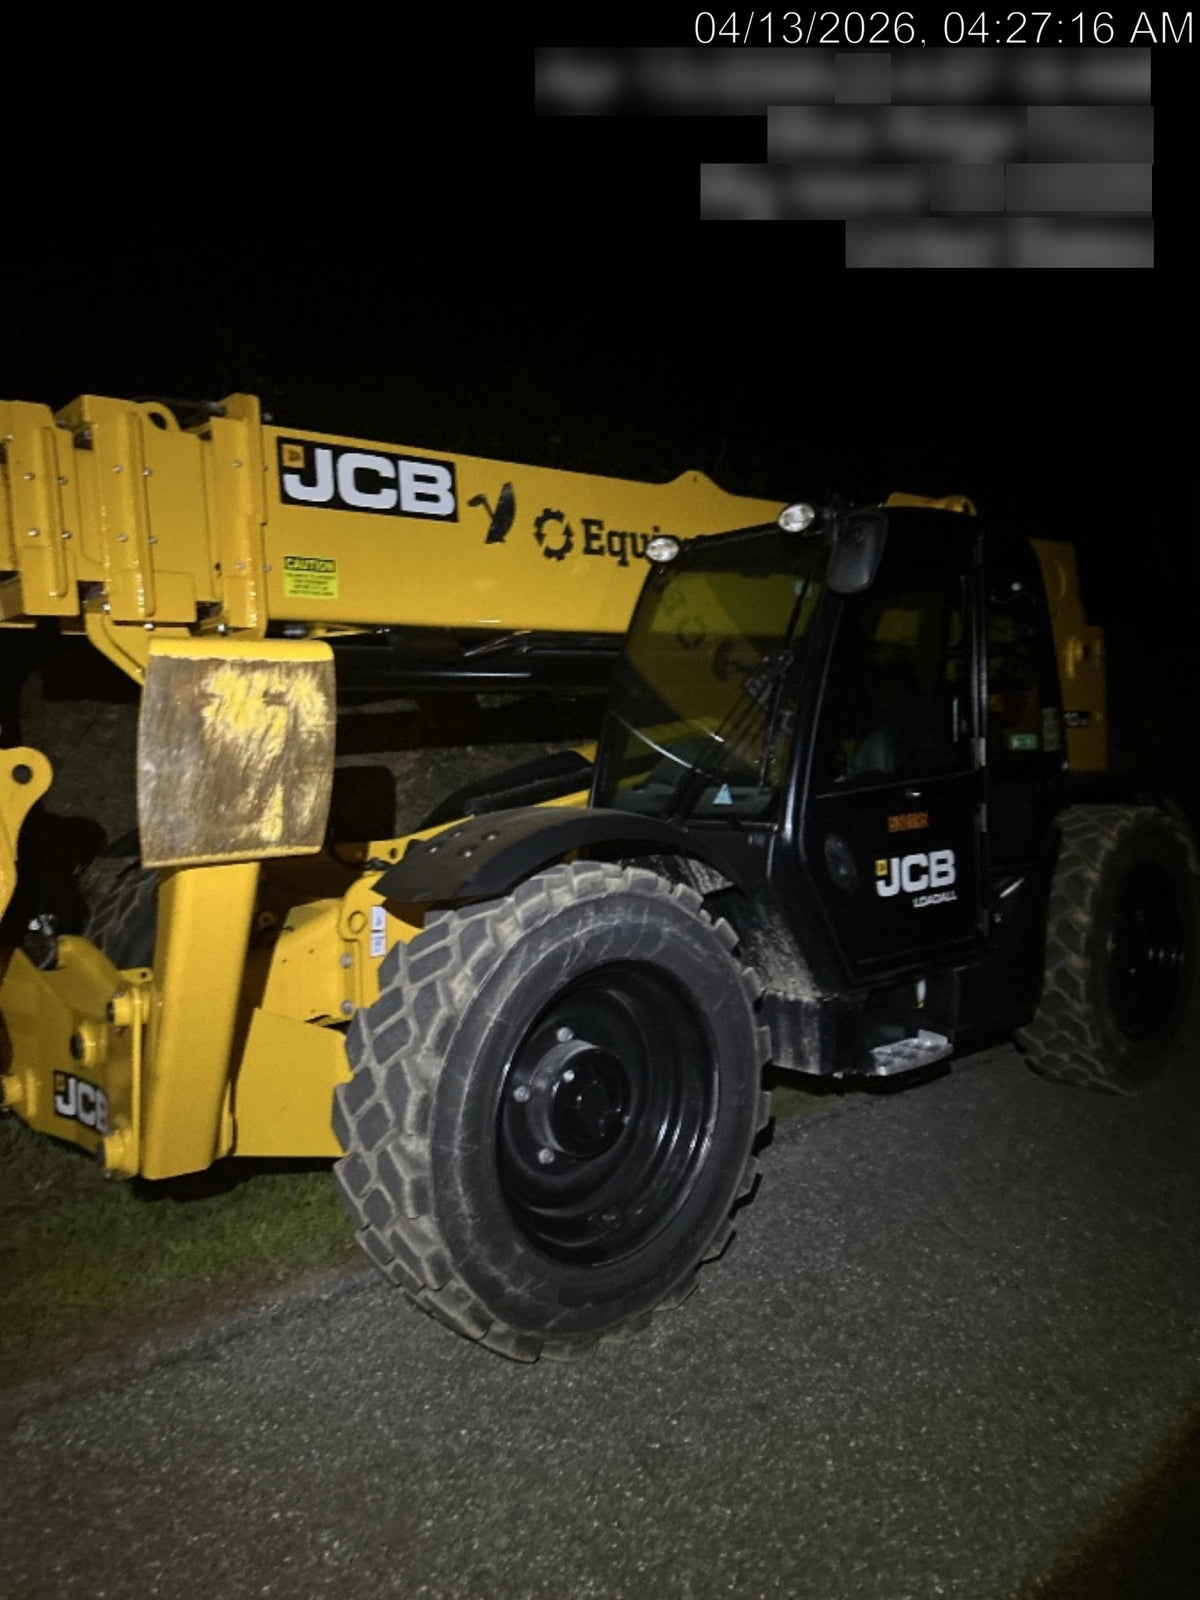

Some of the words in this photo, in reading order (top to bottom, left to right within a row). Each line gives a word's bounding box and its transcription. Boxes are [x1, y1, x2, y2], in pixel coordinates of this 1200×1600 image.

[281, 446, 456, 517] JCB
[875, 848, 956, 898] JCB
[54, 1076, 109, 1135] JCB
